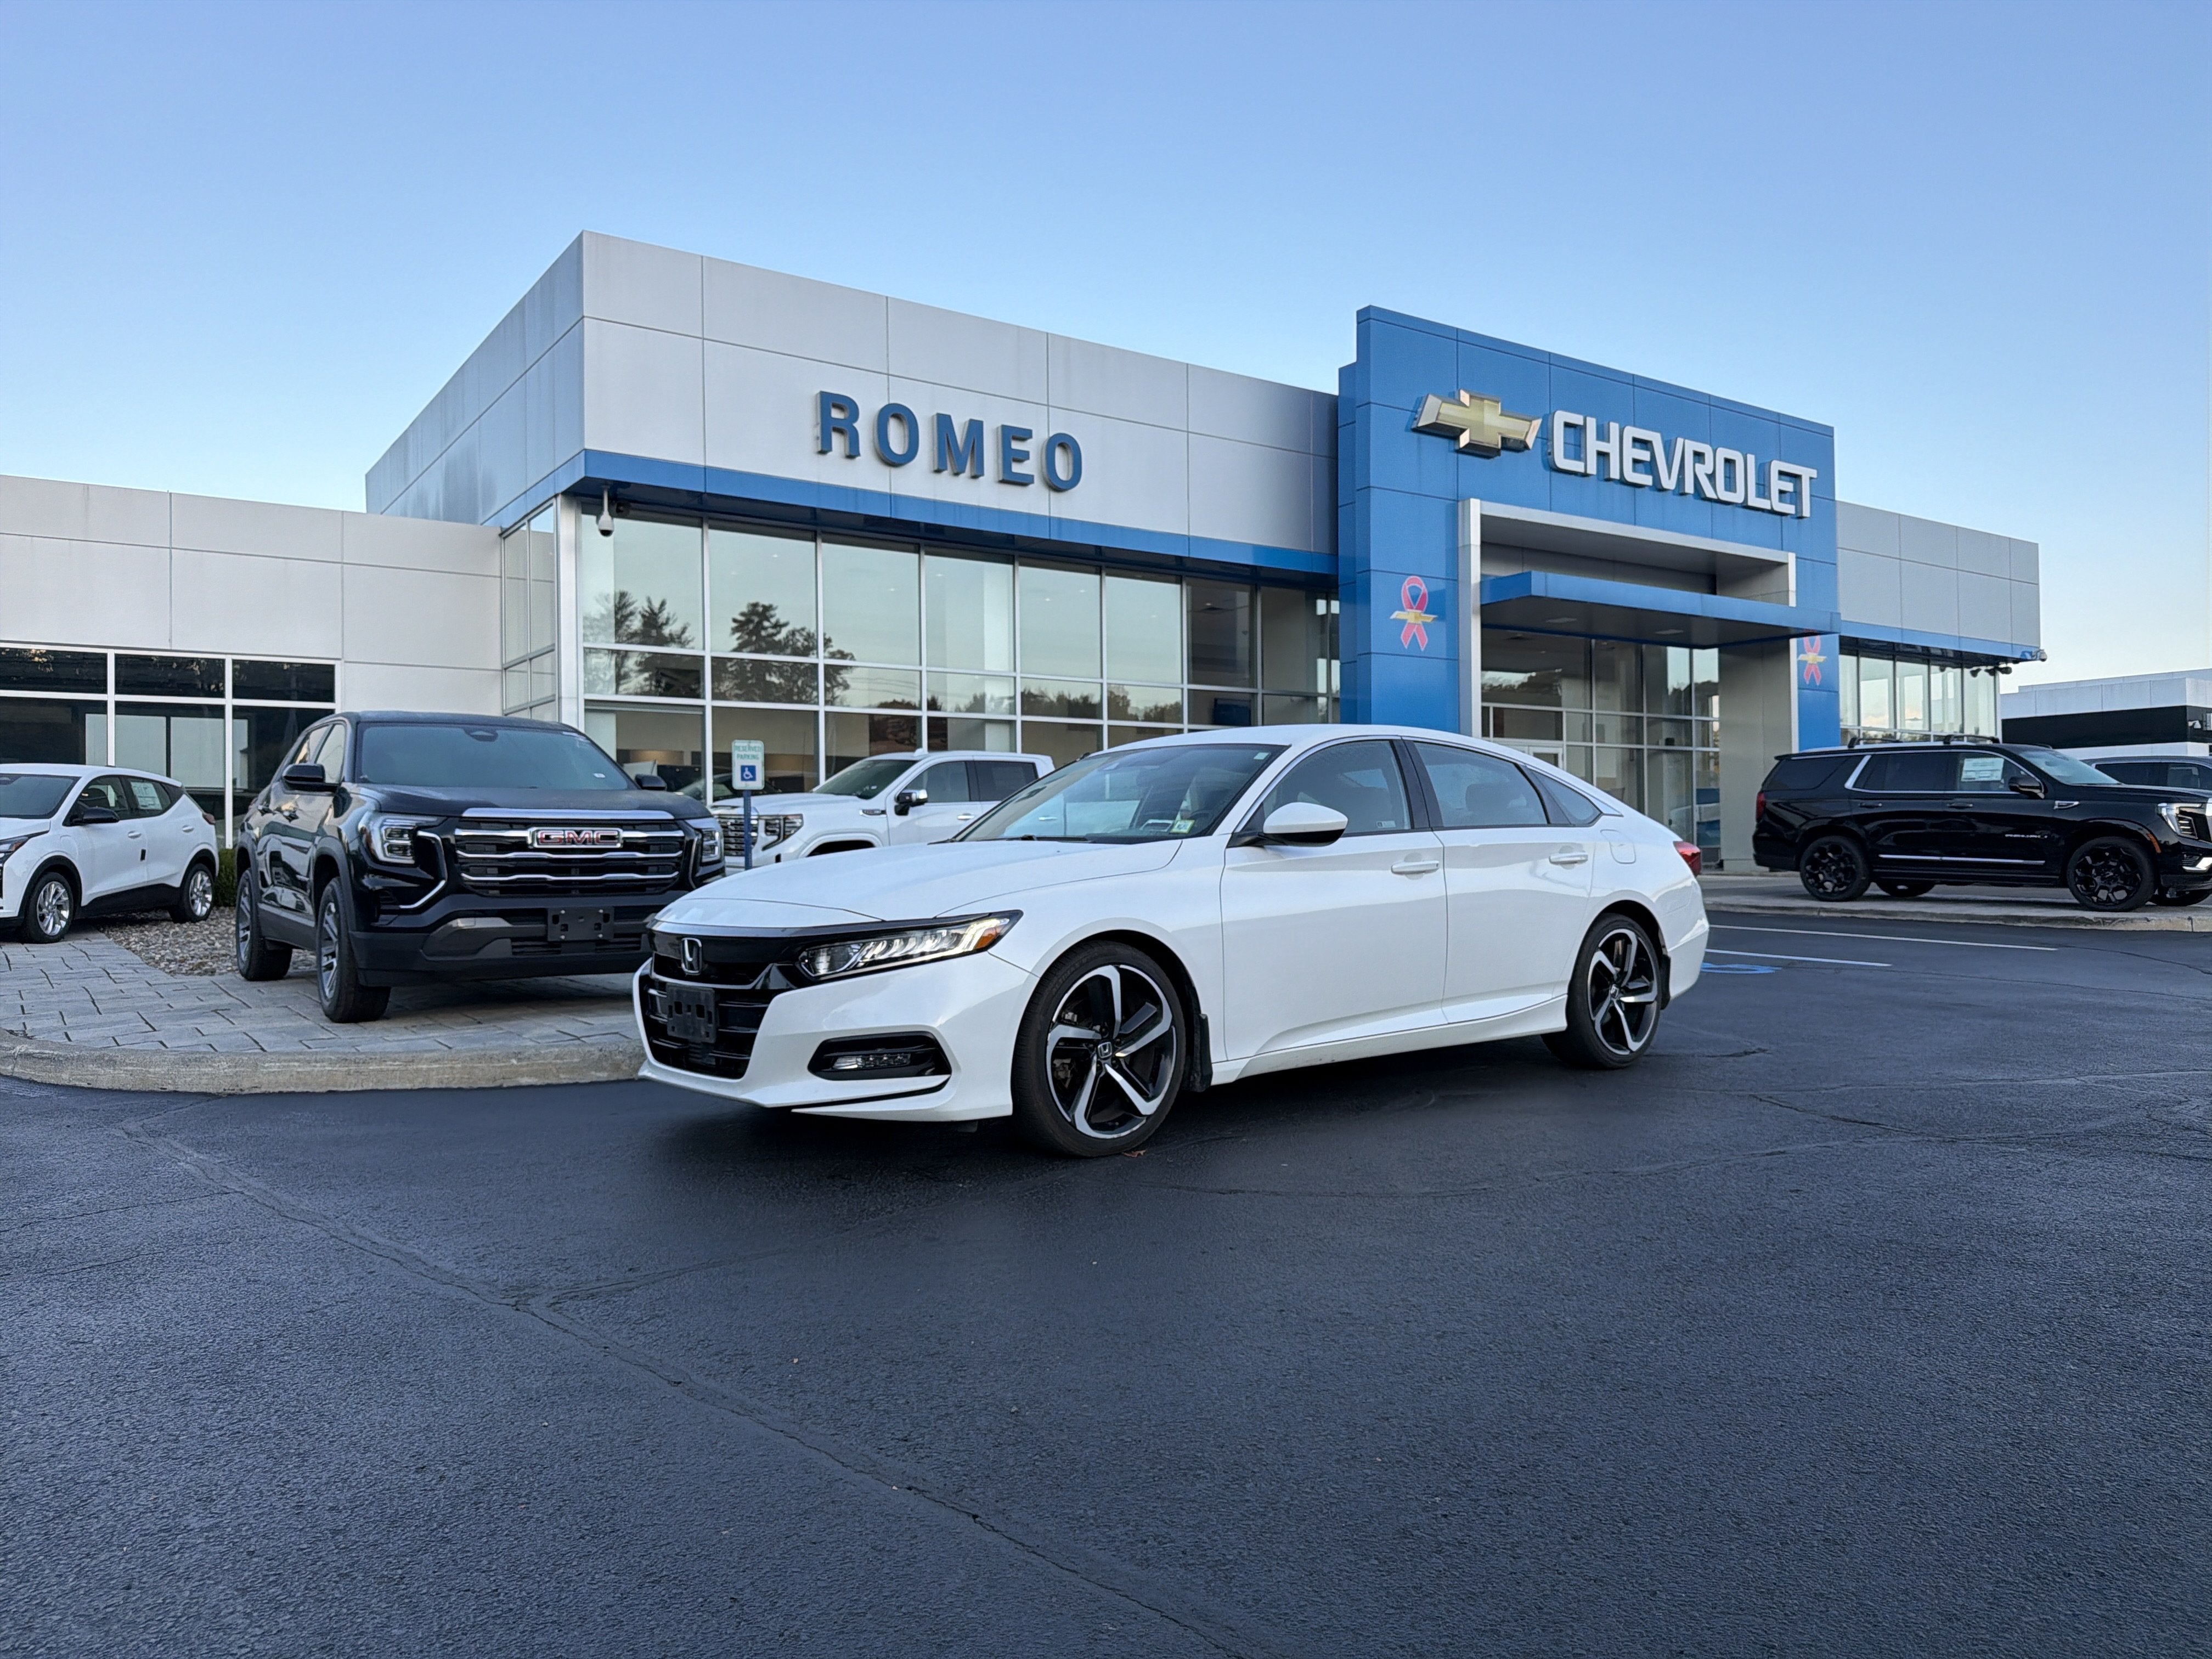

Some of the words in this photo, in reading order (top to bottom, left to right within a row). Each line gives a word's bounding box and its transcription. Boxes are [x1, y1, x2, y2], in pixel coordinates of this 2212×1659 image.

[816, 391, 1082, 492] ROMEO
[1549, 410, 1818, 518] CHEVROLET
[538, 830, 619, 845] GMC
